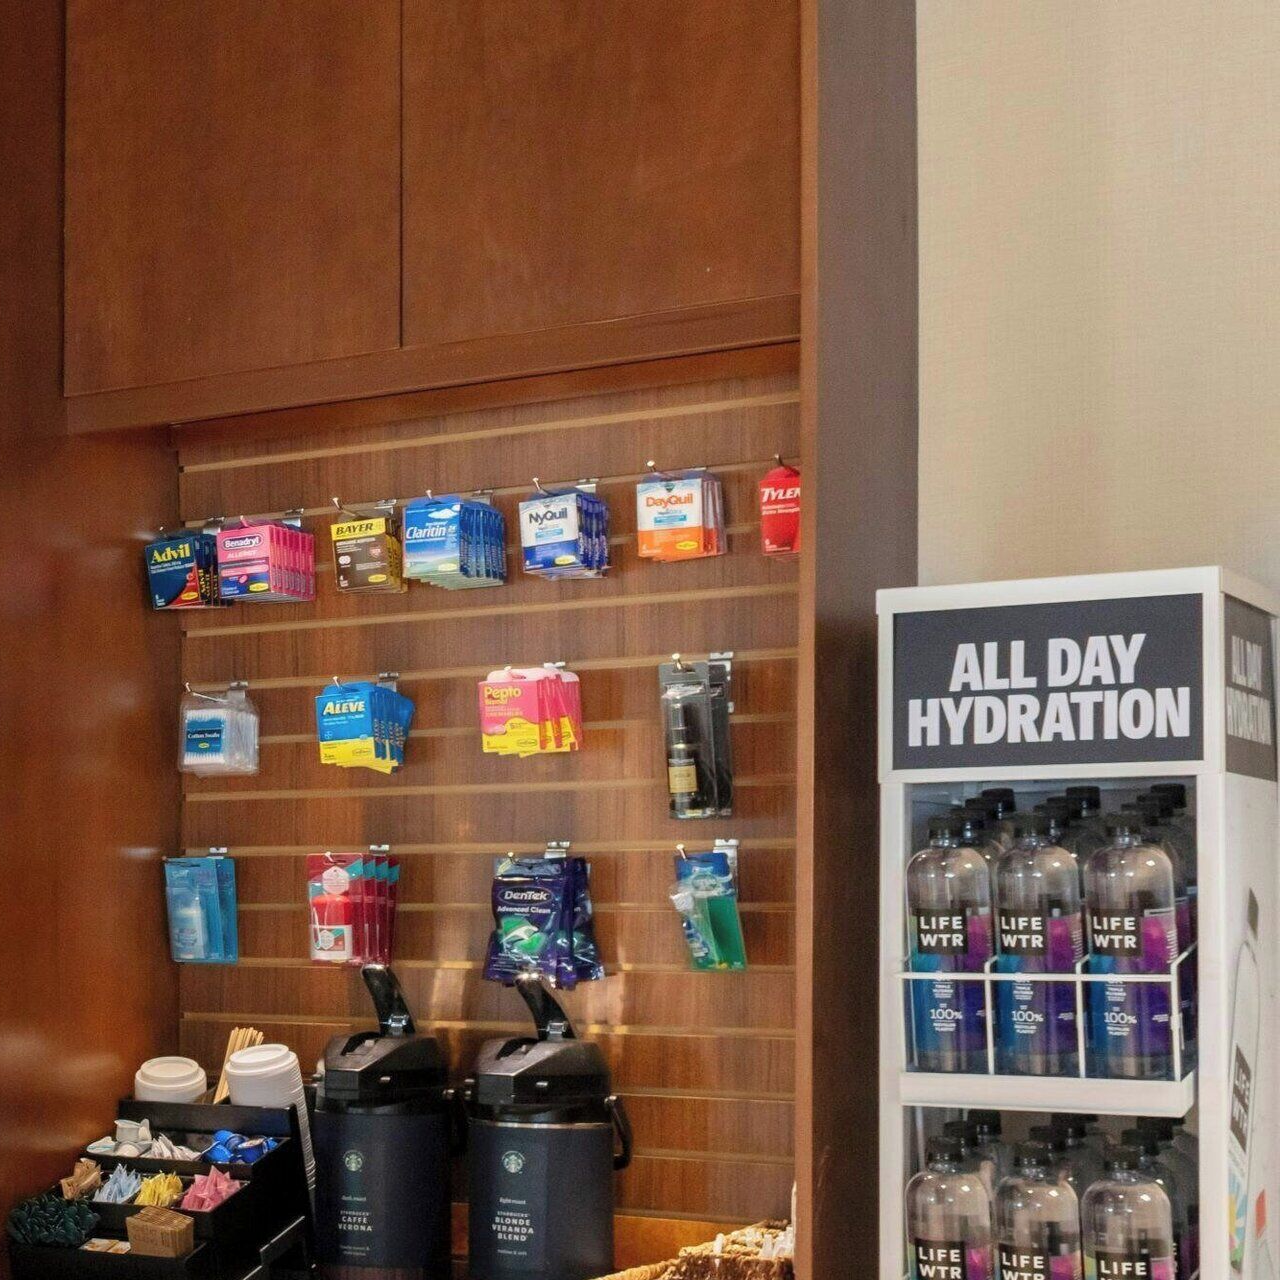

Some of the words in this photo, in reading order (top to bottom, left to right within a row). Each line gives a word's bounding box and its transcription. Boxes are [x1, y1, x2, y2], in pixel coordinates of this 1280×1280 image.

[646, 494, 693, 509] DayQuil
[529, 507, 567, 524] NyQuil
[335, 523, 373, 535] BAYER
[405, 525, 445, 541] Claritin
[225, 538, 259, 548] Benadryl
[151, 544, 190, 565] Advil
[949, 640, 1037, 692] ALL
[1047, 633, 1146, 687] DAY
[484, 686, 521, 700] Pepto
[323, 700, 366, 716] ALEVE
[908, 687, 1190, 747] HYDRATION
[504, 890, 548, 902] DenTek
[920, 917, 963, 930] LIFE
[1001, 917, 1042, 930] LIFE
[1093, 916, 1136, 930] LIFE
[921, 934, 964, 948] WTR
[1001, 934, 1044, 948] WTR
[1093, 934, 1137, 949] WTR
[929, 1008, 963, 1020] 100%
[1011, 1010, 1044, 1022] 100%
[1104, 1012, 1137, 1024] 100%
[338, 1224, 372, 1232] VERONA
[495, 1217, 530, 1225] BLONDE
[492, 1225, 534, 1234] VERANDA
[497, 1233, 527, 1241] BLEND
[919, 1247, 961, 1262] LIFE
[1001, 1254, 1044, 1269] LIFE
[919, 1265, 962, 1280] WTR
[1099, 1260, 1147, 1275] LIFE
